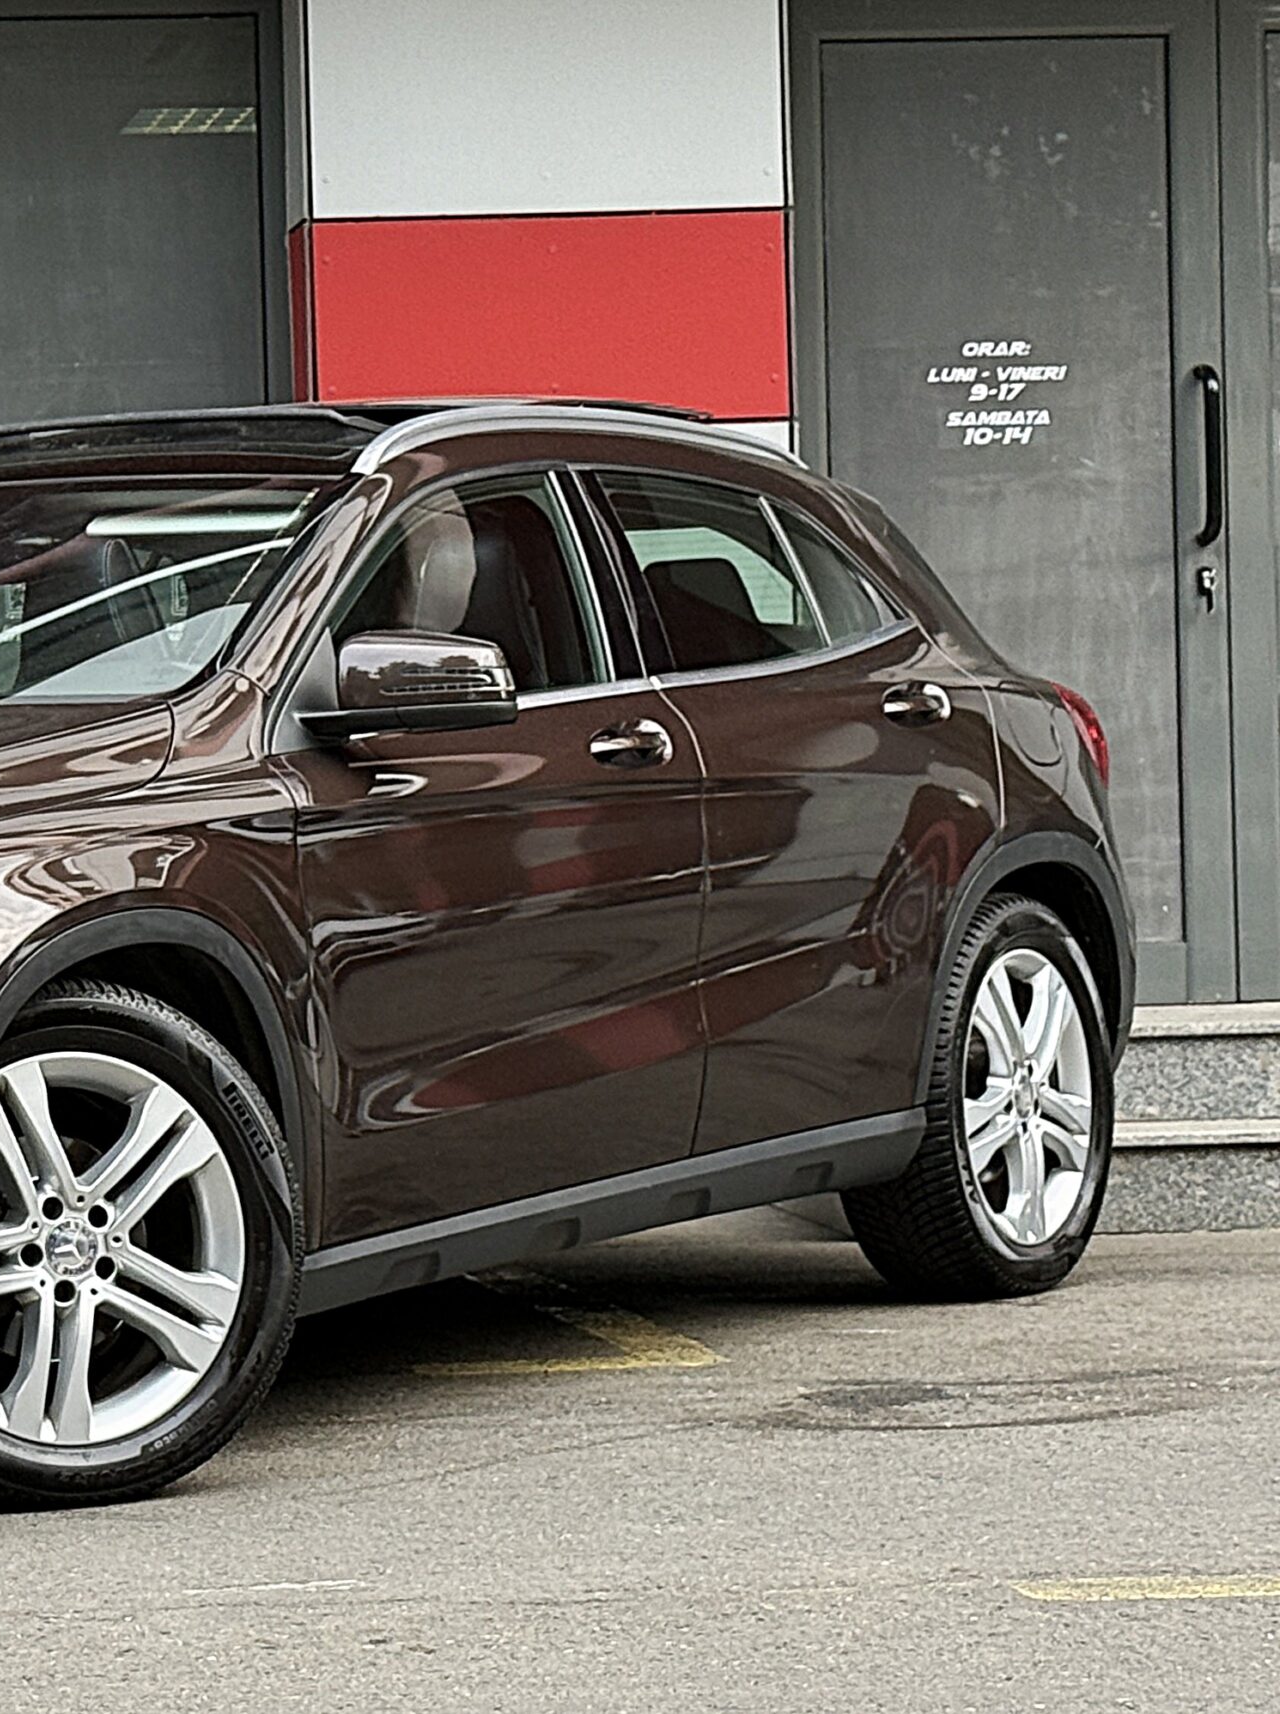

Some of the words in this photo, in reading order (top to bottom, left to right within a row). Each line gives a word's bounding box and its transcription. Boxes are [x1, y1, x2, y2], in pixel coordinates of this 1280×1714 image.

[961, 340, 1032, 358] ORAR:
[926, 366, 978, 383] LUNI
[996, 364, 1068, 382] VINERI
[967, 382, 1027, 402] 9-17
[945, 409, 1052, 427] SAMBATA
[962, 426, 1034, 445] 10-14
